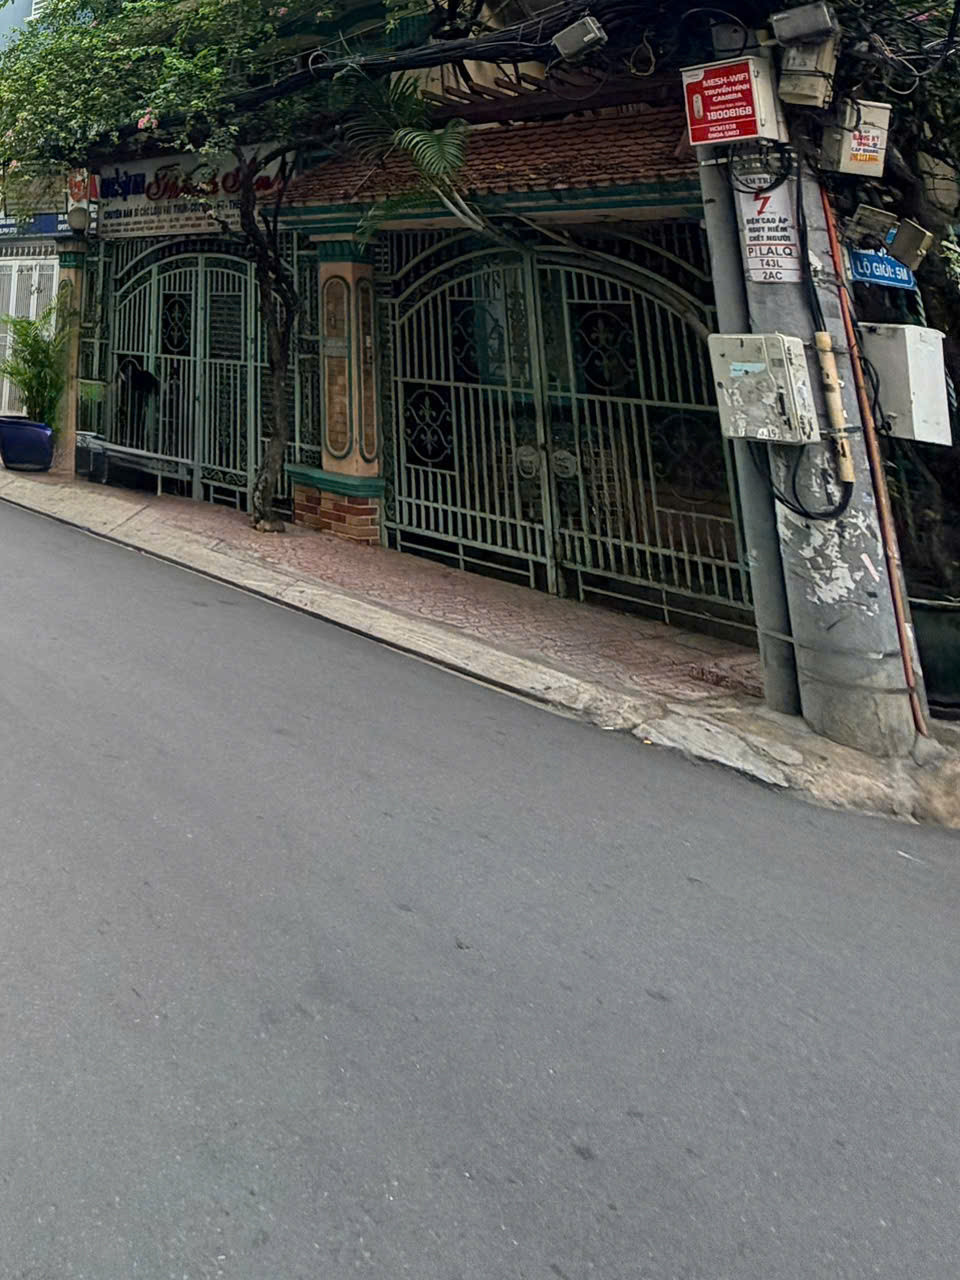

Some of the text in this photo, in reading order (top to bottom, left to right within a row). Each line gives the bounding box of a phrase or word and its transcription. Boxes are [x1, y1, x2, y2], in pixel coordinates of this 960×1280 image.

[702, 72, 749, 88] MESH-WIFI
[706, 106, 752, 120] 18008168
[760, 259, 783, 268] T43L
[857, 258, 871, 276] LỘ
[762, 271, 782, 280] 2AC
